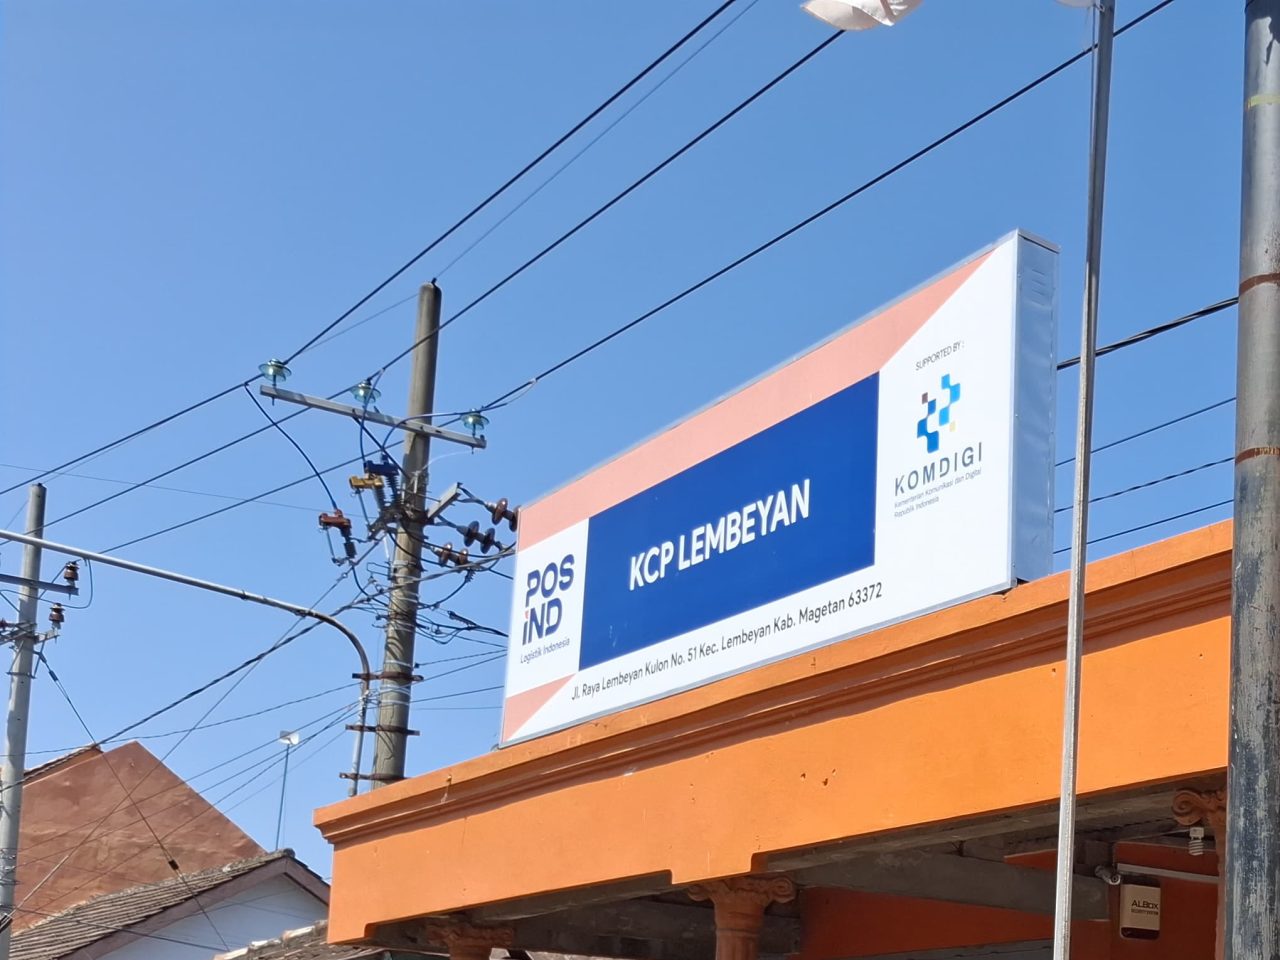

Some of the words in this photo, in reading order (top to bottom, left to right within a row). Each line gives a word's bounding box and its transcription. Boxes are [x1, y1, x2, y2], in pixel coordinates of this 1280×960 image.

[916, 346, 952, 370] SUPPORTED
[895, 442, 982, 496] KOMDIGI
[630, 541, 674, 591] KCP
[678, 478, 810, 570] LEMBEYAN
[525, 554, 575, 608] POS
[520, 646, 542, 664] Logistik
[543, 637, 570, 655] Indonesia
[582, 683, 600, 698] Raya
[602, 668, 643, 690] Lembeyan
[645, 657, 669, 677] Kulon
[671, 651, 685, 666] No.
[688, 646, 697, 661] 51
[699, 642, 719, 659] Kec.
[722, 624, 771, 650] Lembeyan
[774, 613, 796, 634] Kab.
[799, 598, 845, 625] Magetan
[849, 582, 882, 608] 63372
